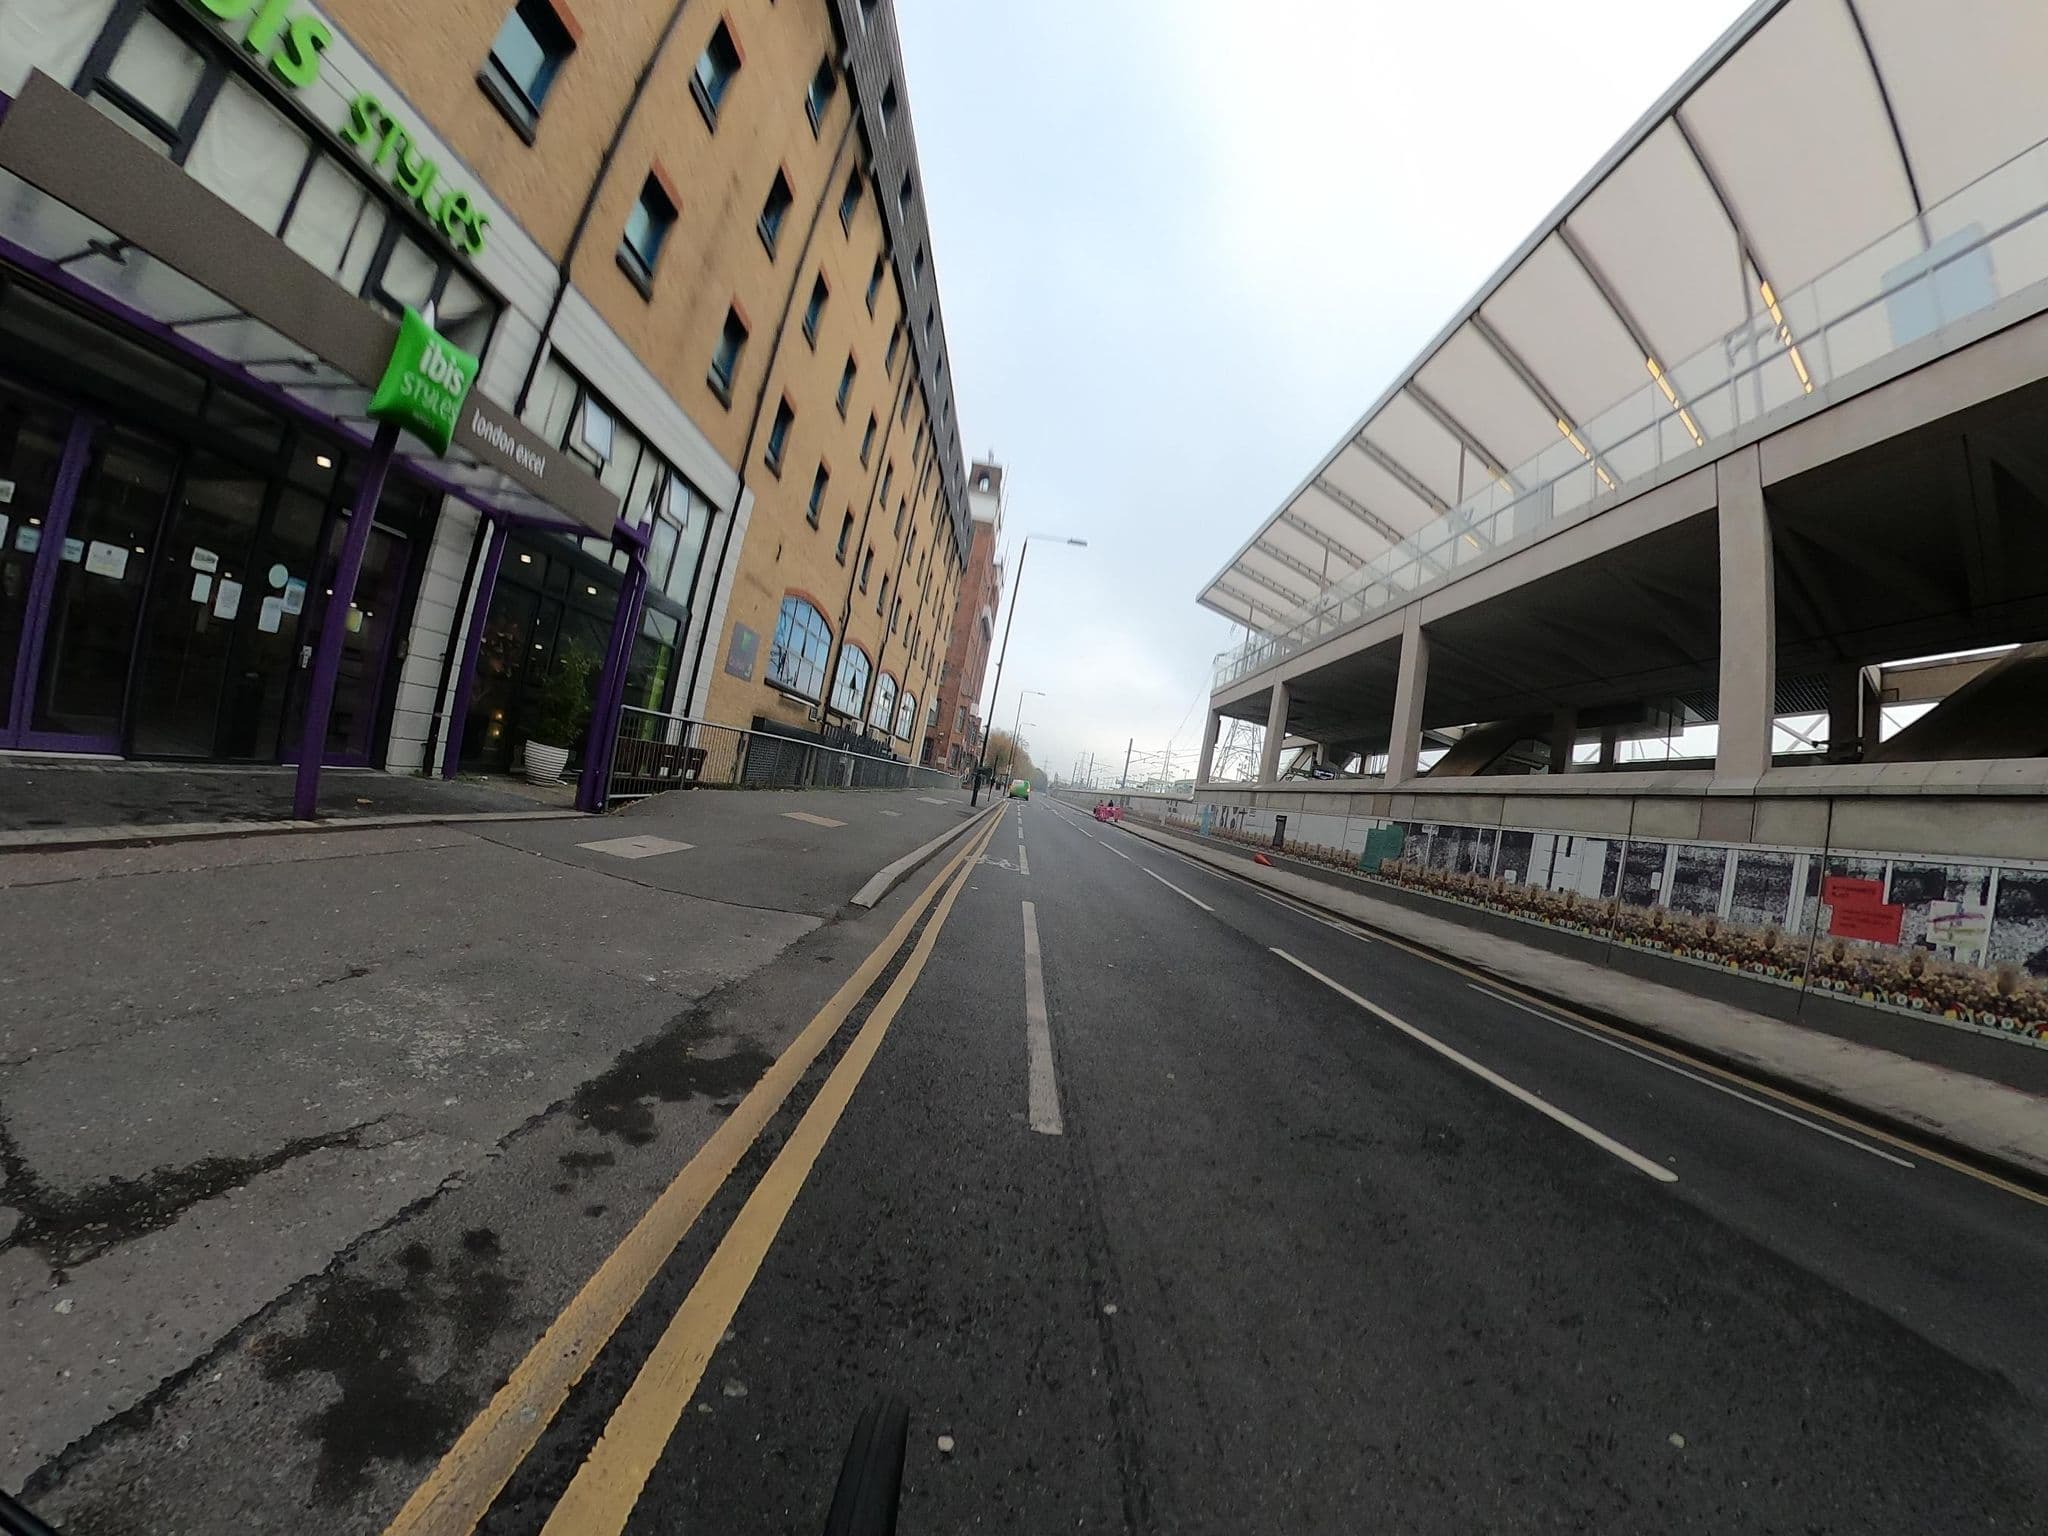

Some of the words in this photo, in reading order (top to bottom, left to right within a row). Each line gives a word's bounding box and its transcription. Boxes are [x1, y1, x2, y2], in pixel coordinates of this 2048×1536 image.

[419, 338, 465, 398] ibis
[471, 407, 515, 457] london
[515, 443, 546, 478] excel
